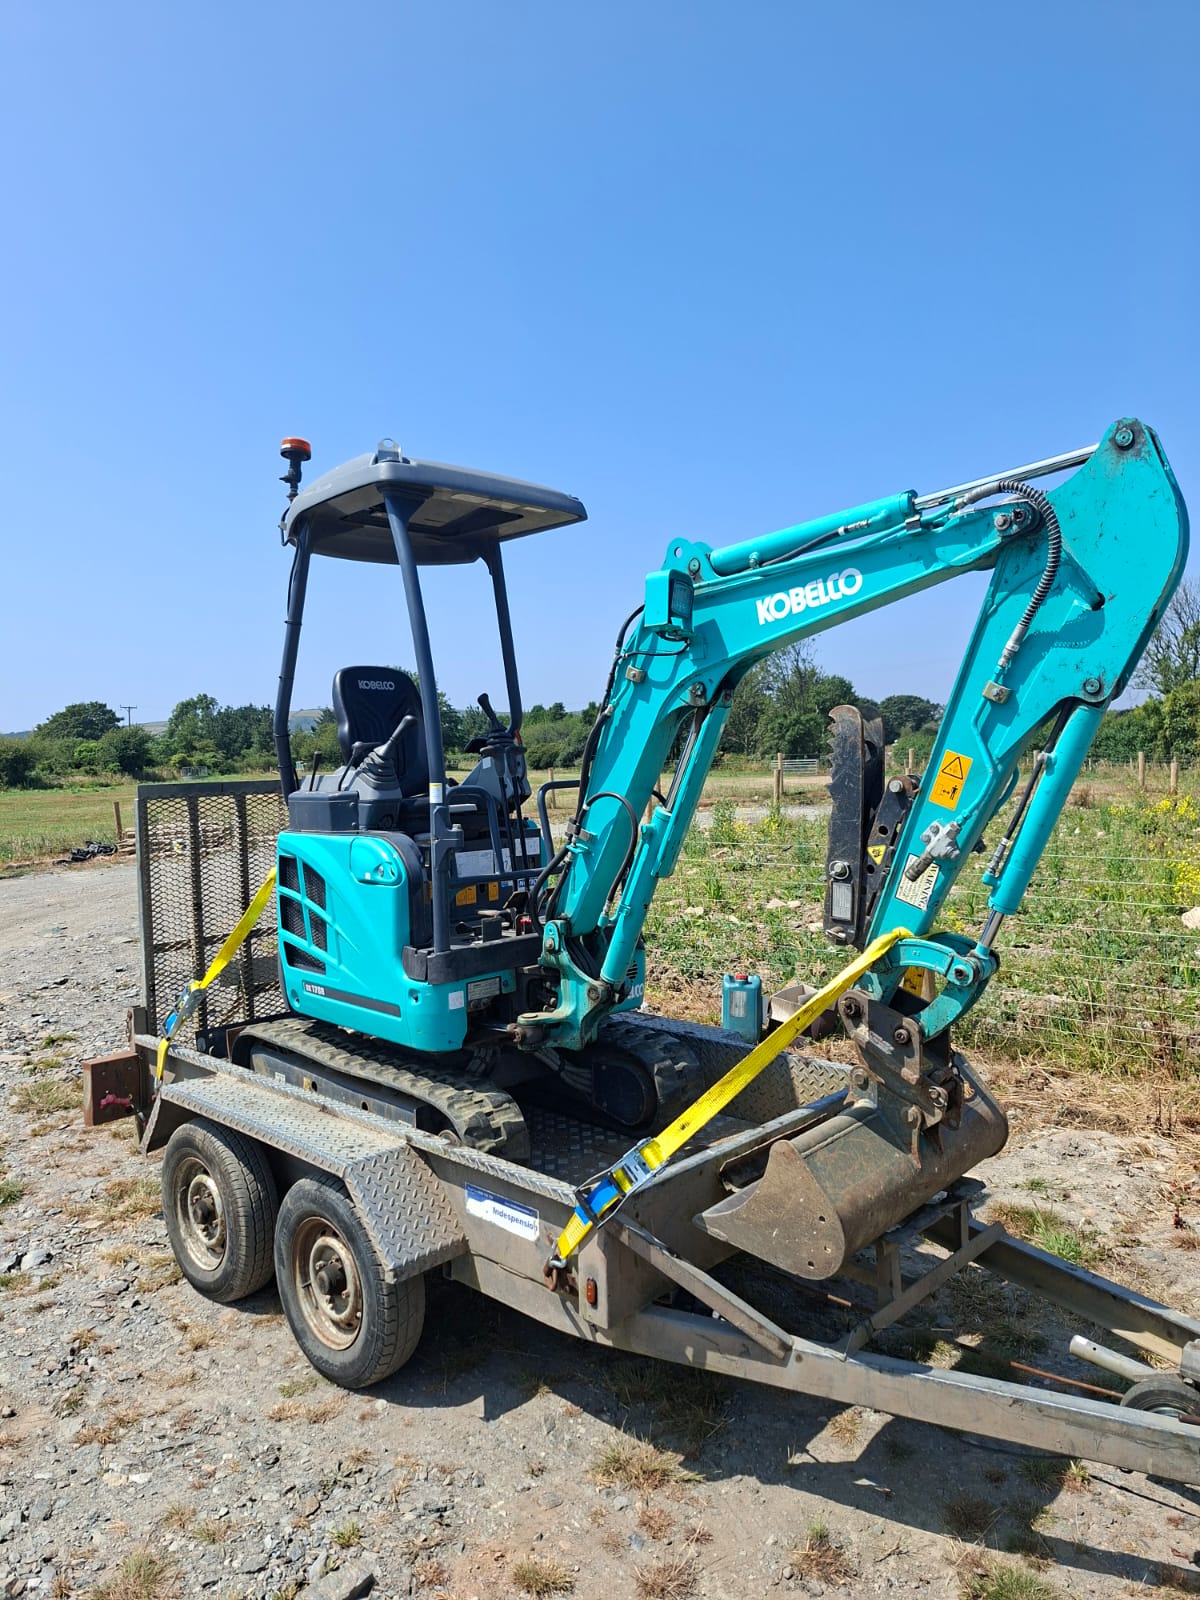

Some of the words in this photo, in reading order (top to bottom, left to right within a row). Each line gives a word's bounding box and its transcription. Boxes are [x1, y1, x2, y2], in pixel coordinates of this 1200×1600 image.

[756, 568, 863, 626] KOBELCO
[358, 680, 395, 690] KOBELCO
[918, 865, 938, 910] WARNING
